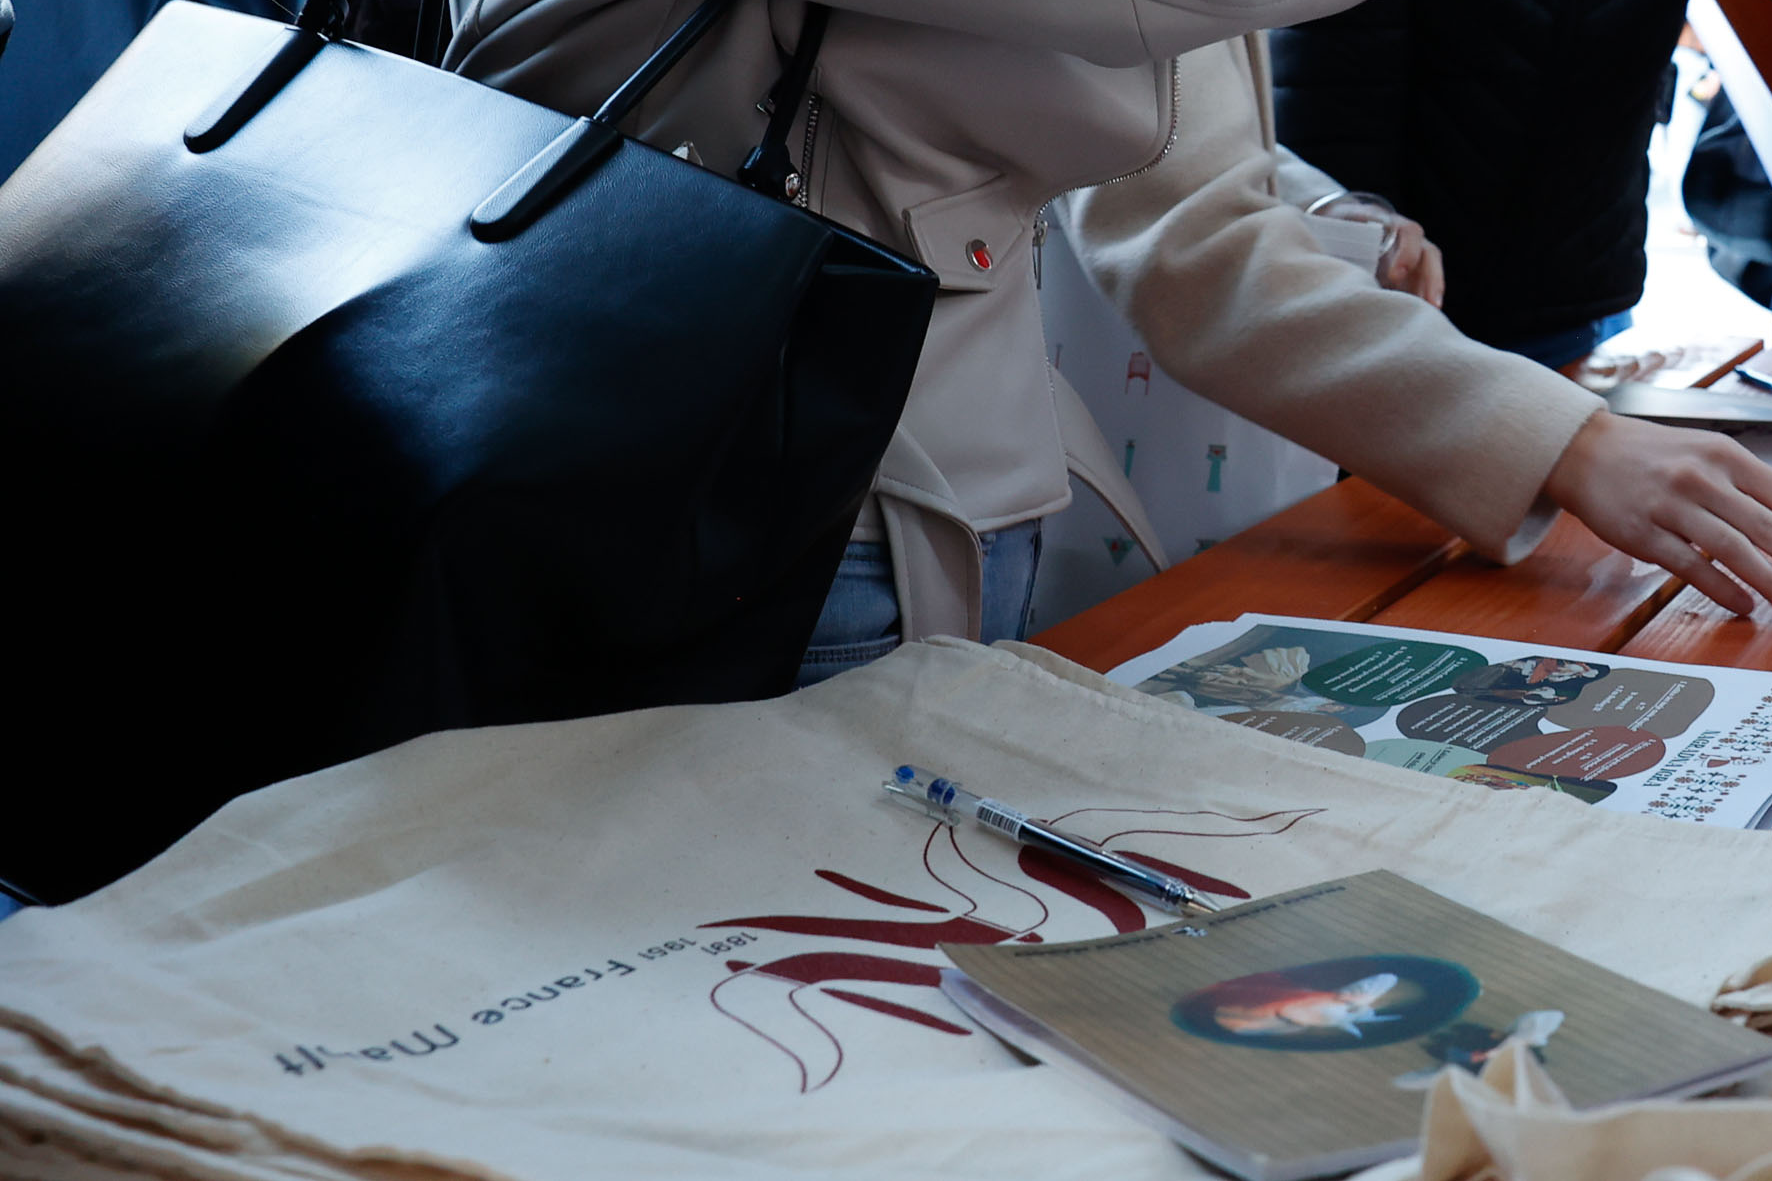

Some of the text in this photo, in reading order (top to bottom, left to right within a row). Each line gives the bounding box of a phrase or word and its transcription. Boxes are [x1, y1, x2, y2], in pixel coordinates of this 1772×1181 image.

[1664, 729, 1722, 768] NAGRADNA
[1642, 767, 1679, 788] IGRA
[700, 930, 759, 957] 1891
[470, 958, 637, 1025] France
[273, 1022, 461, 1078] Malt
